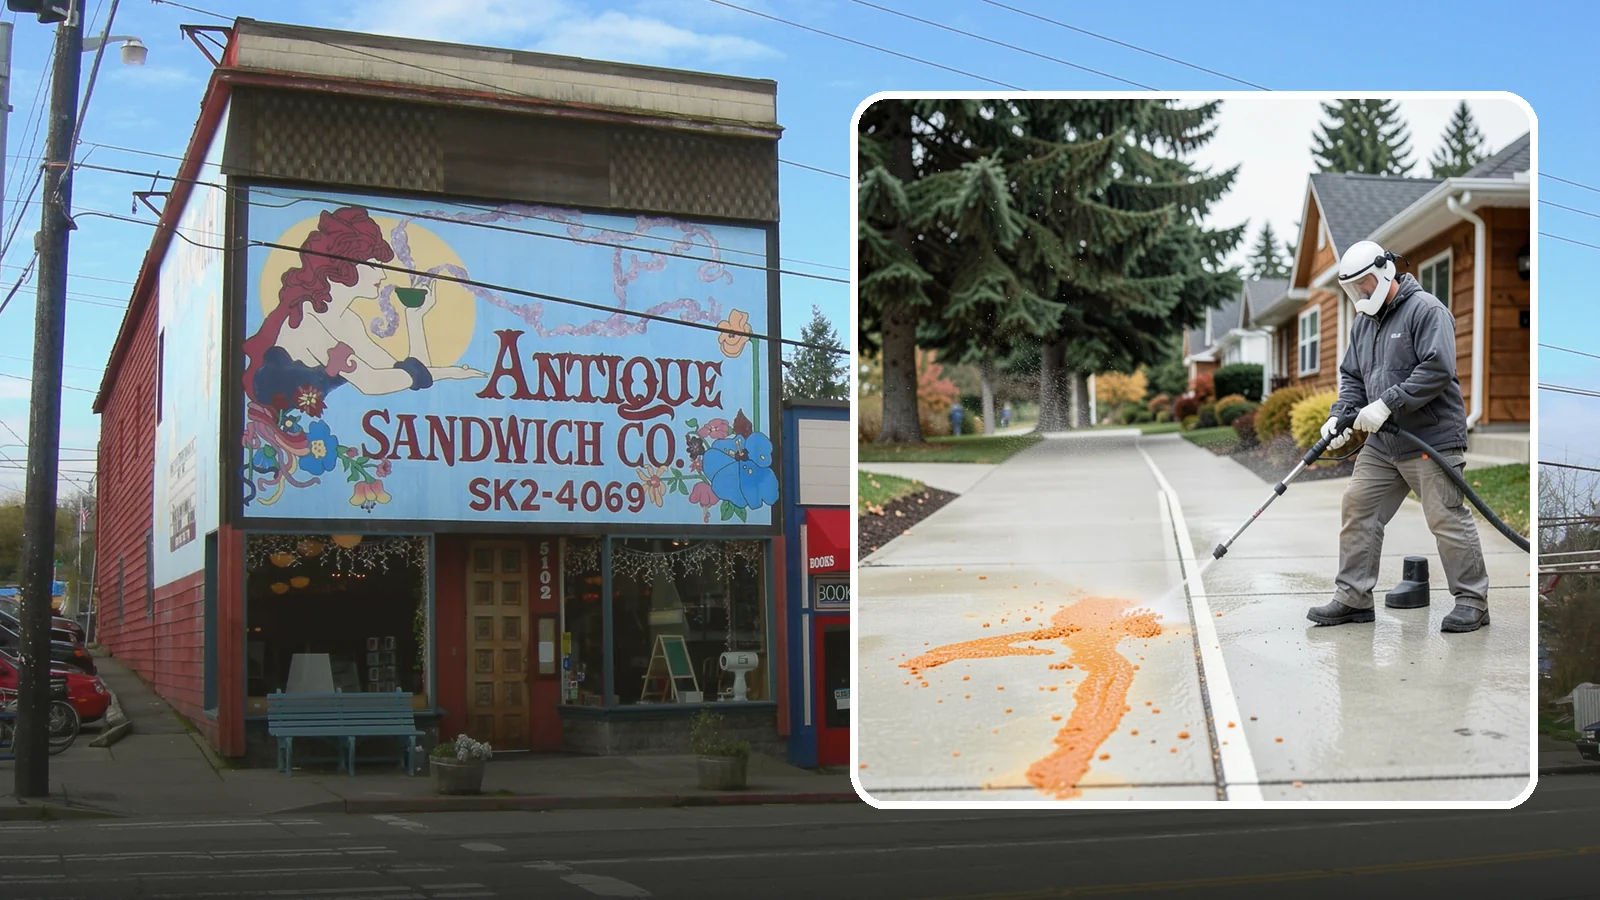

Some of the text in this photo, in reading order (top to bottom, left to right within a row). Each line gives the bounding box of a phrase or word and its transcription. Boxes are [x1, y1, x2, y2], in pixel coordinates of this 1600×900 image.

[476, 330, 724, 421] ANTIQUE
[361, 408, 685, 469] SANDWICH CO.
[468, 477, 646, 512] SK2-4069
[540, 542, 552, 600] 5102
[809, 555, 835, 568] BOOKS
